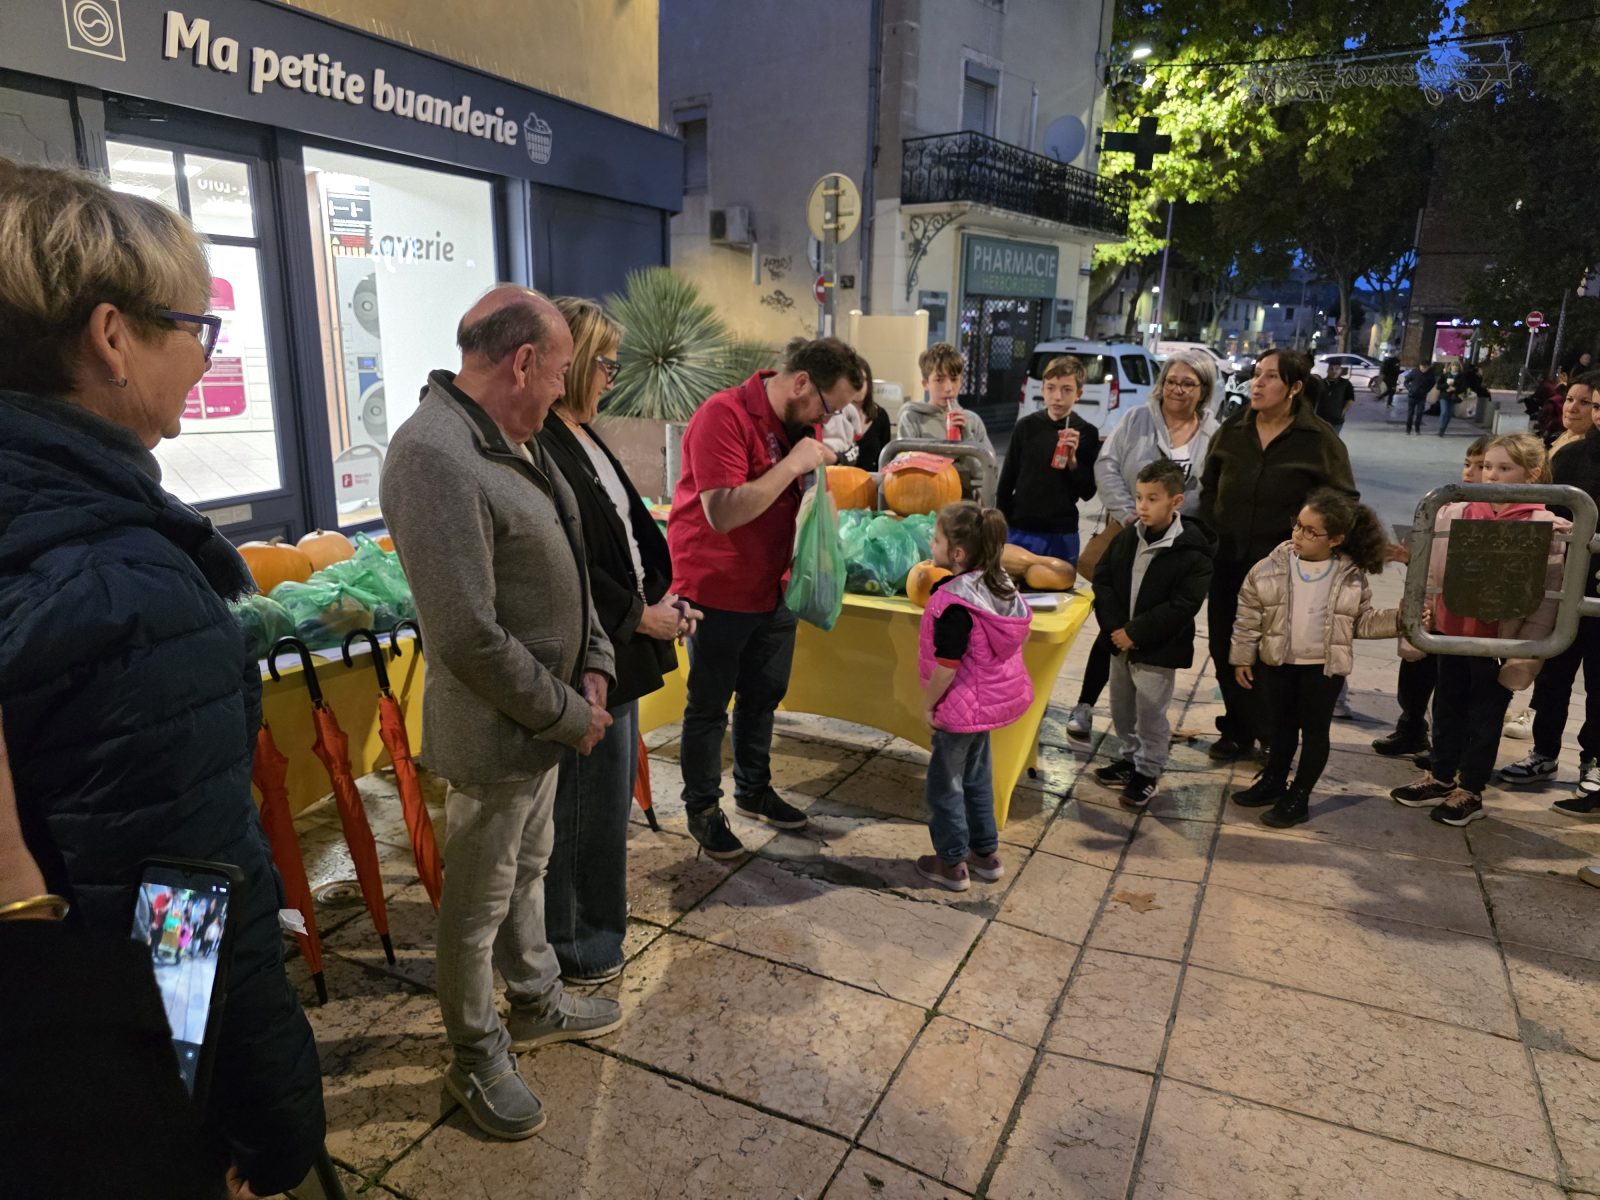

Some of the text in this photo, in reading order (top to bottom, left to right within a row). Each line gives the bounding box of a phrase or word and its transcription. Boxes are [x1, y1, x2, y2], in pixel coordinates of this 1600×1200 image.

[165, 10, 519, 146] Ma petite buanderie
[973, 245, 1056, 278] PHARMACIE
